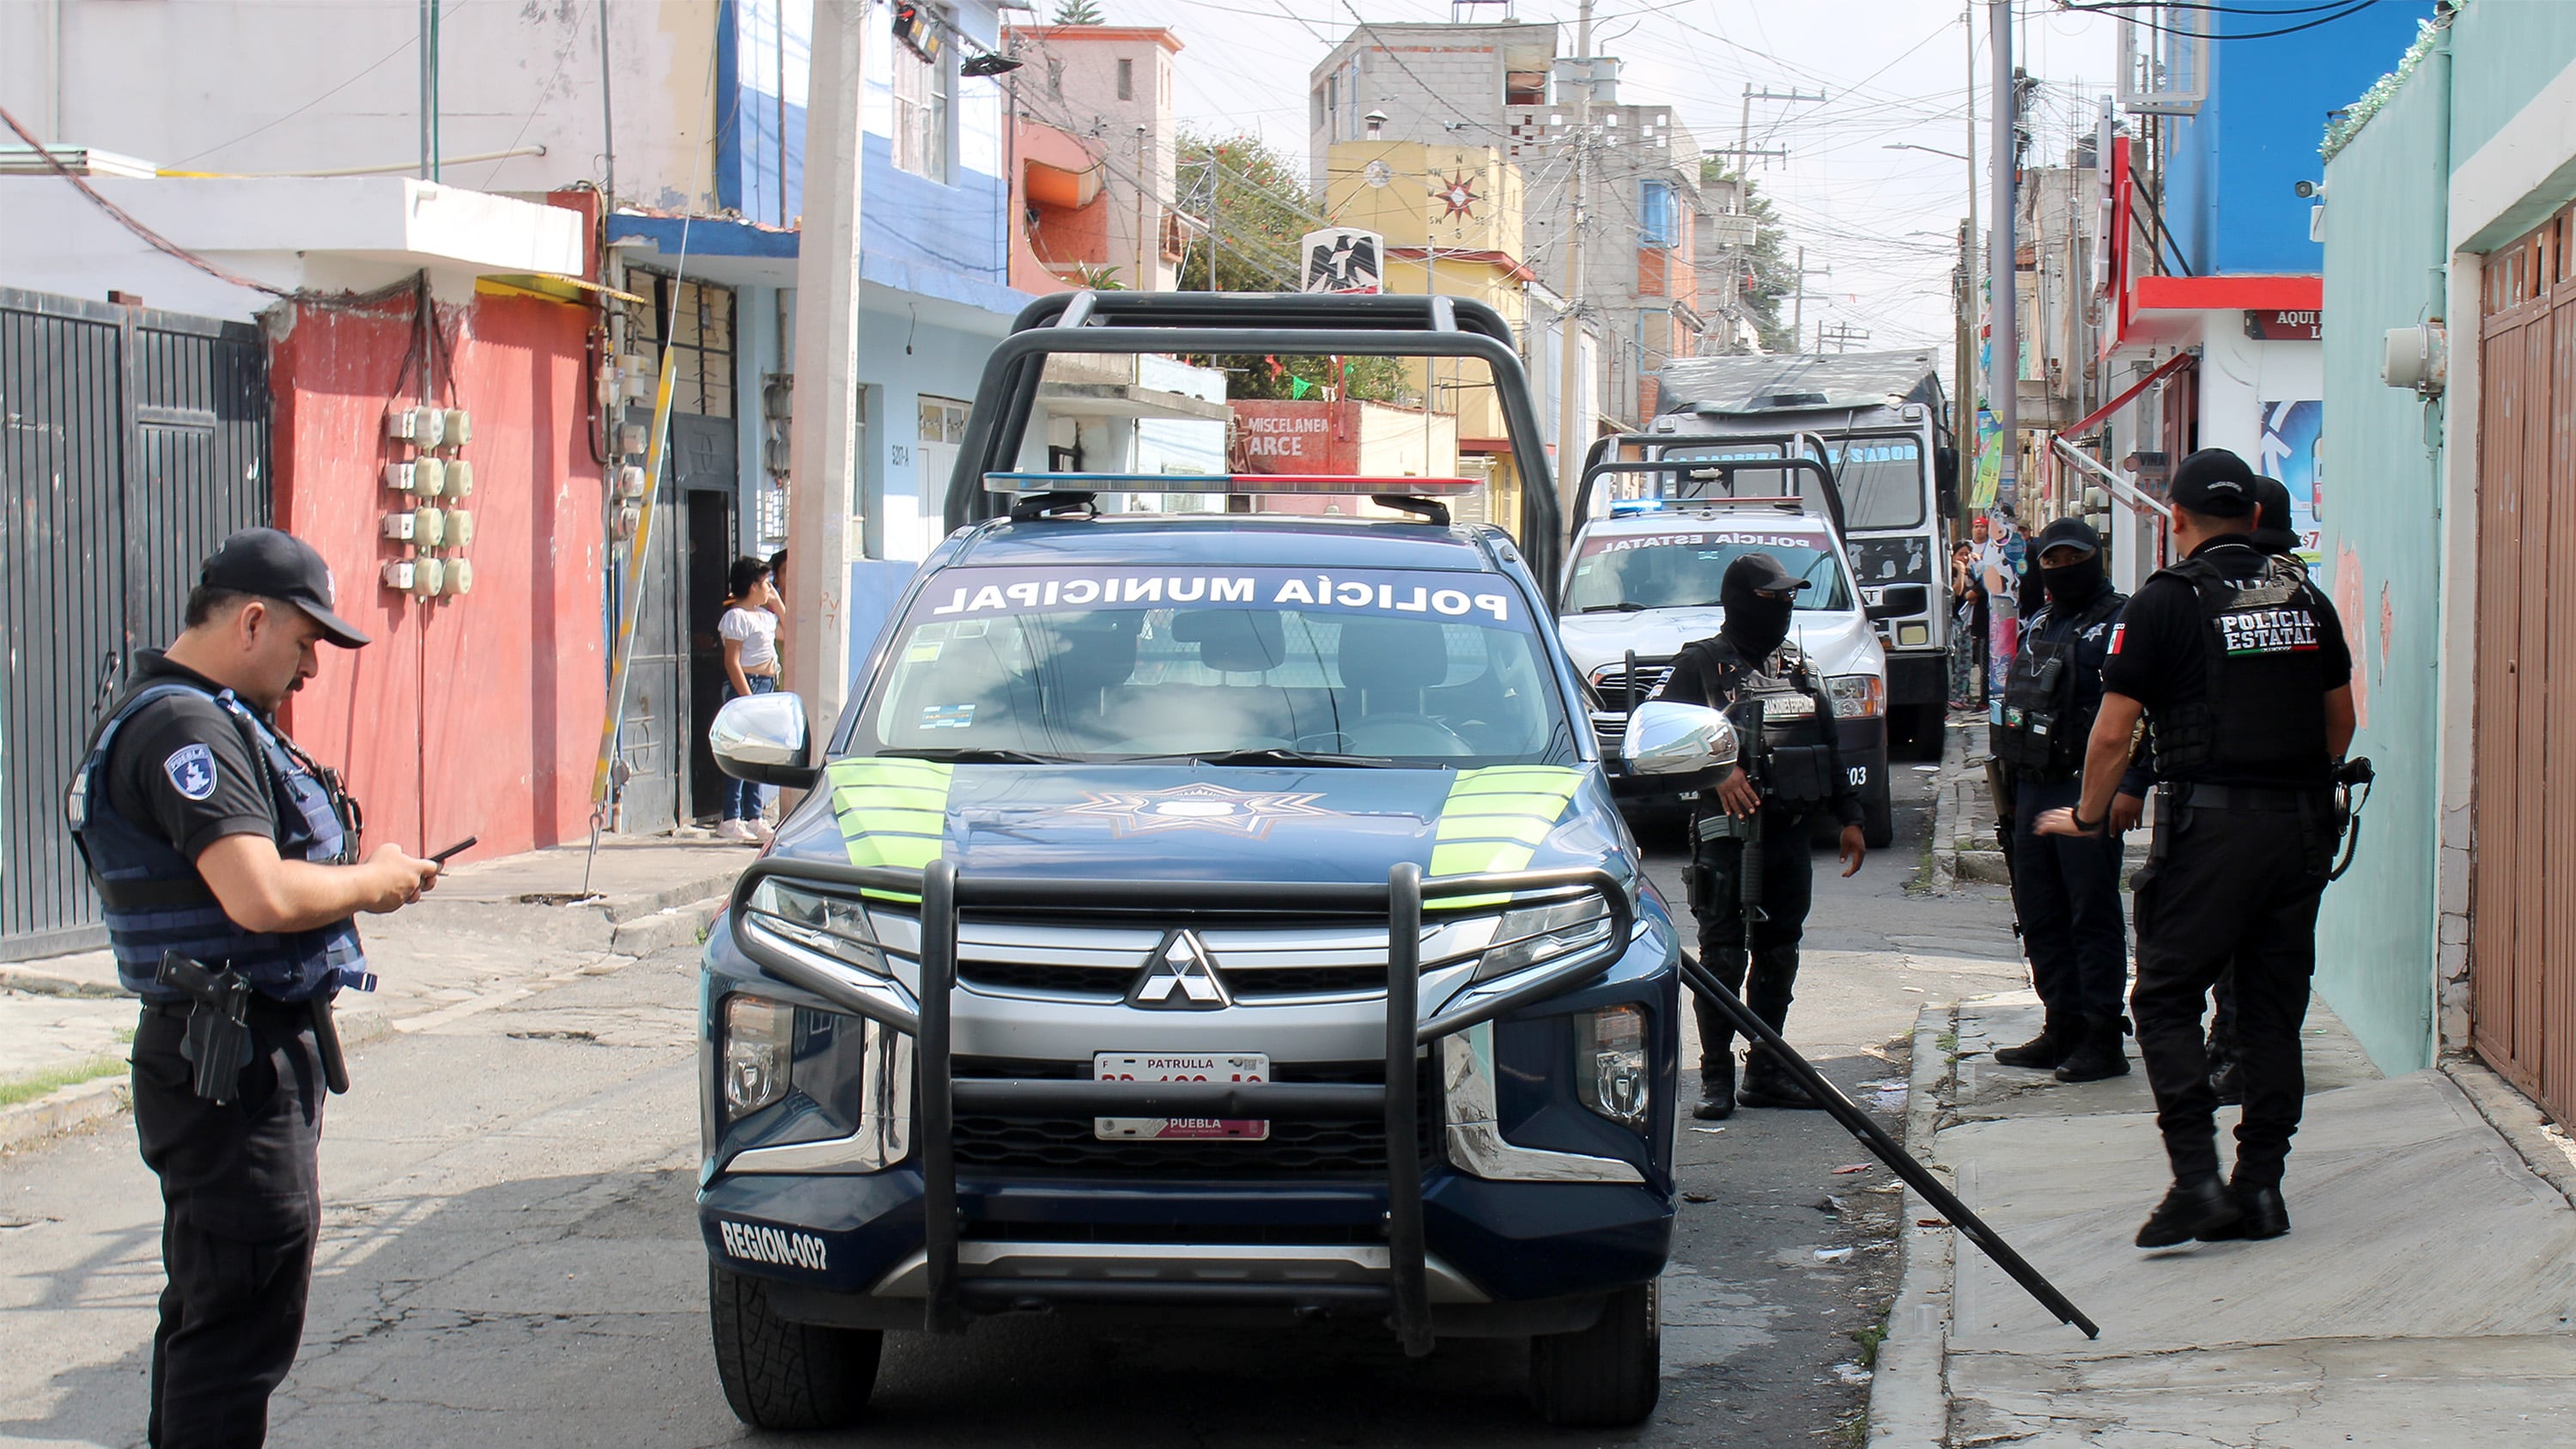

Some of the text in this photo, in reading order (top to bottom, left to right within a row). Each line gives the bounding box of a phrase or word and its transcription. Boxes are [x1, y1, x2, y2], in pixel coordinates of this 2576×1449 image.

[1455, 155, 1463, 164] N
[1429, 216, 1443, 225] SW
[2275, 311, 2316, 327] AQUI
[1248, 417, 1329, 433] MISCELANEA
[1249, 435, 1303, 456] ARCE
[2221, 610, 2314, 633] POLICIA
[2225, 627, 2318, 650] ESTATAL
[1846, 766, 1867, 786] 03
[1147, 1059, 1213, 1068] PATRULLA
[1170, 1118, 1221, 1129] PUEBLA
